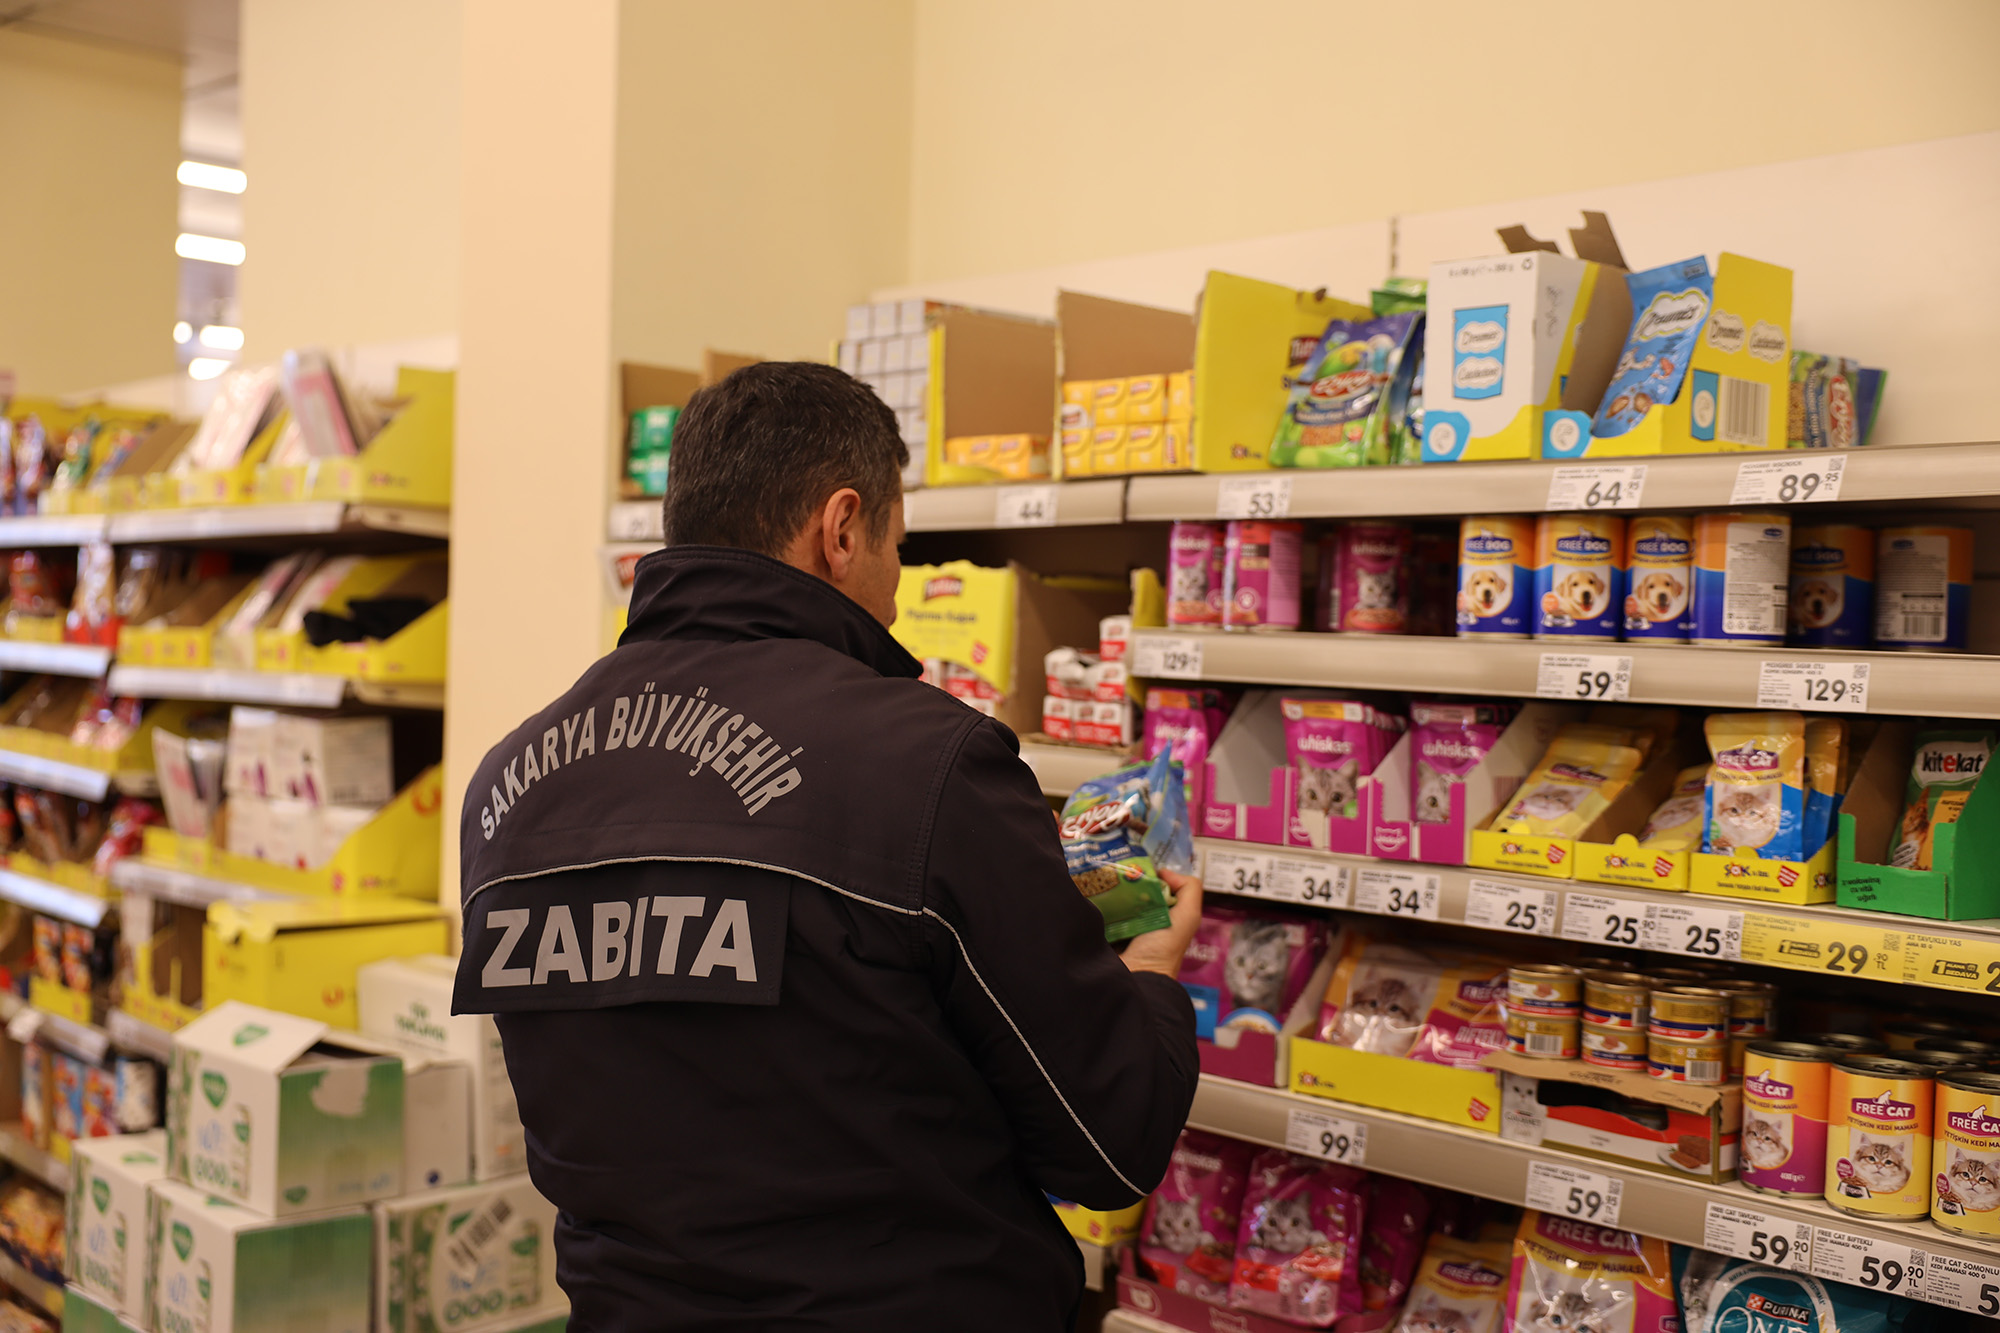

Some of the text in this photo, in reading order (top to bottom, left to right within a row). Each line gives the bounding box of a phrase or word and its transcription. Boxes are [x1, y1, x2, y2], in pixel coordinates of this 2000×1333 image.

[1485, 540, 1510, 551] DOG
[1558, 540, 1609, 551] FREE DOG
[1636, 541, 1687, 553] FREE DOG
[480, 681, 804, 840] SAKARYA BÜYÜKŞEHİR
[1922, 751, 1984, 773] kitekat
[481, 895, 758, 988] ZABITA
[1765, 1085, 1789, 1097] CAT
[1855, 1102, 1911, 1118] FREE CAT
[1951, 1116, 2000, 1134] FREE CA
[1546, 1217, 1595, 1244] FREE
[1818, 1229, 1832, 1238] FREE
[1833, 1232, 1846, 1241] CAT
[1931, 1255, 1999, 1276] FREE CAT SOMONLU
[1944, 1266, 1967, 1275] MAMASI
[1762, 1301, 1807, 1321] PURINA
